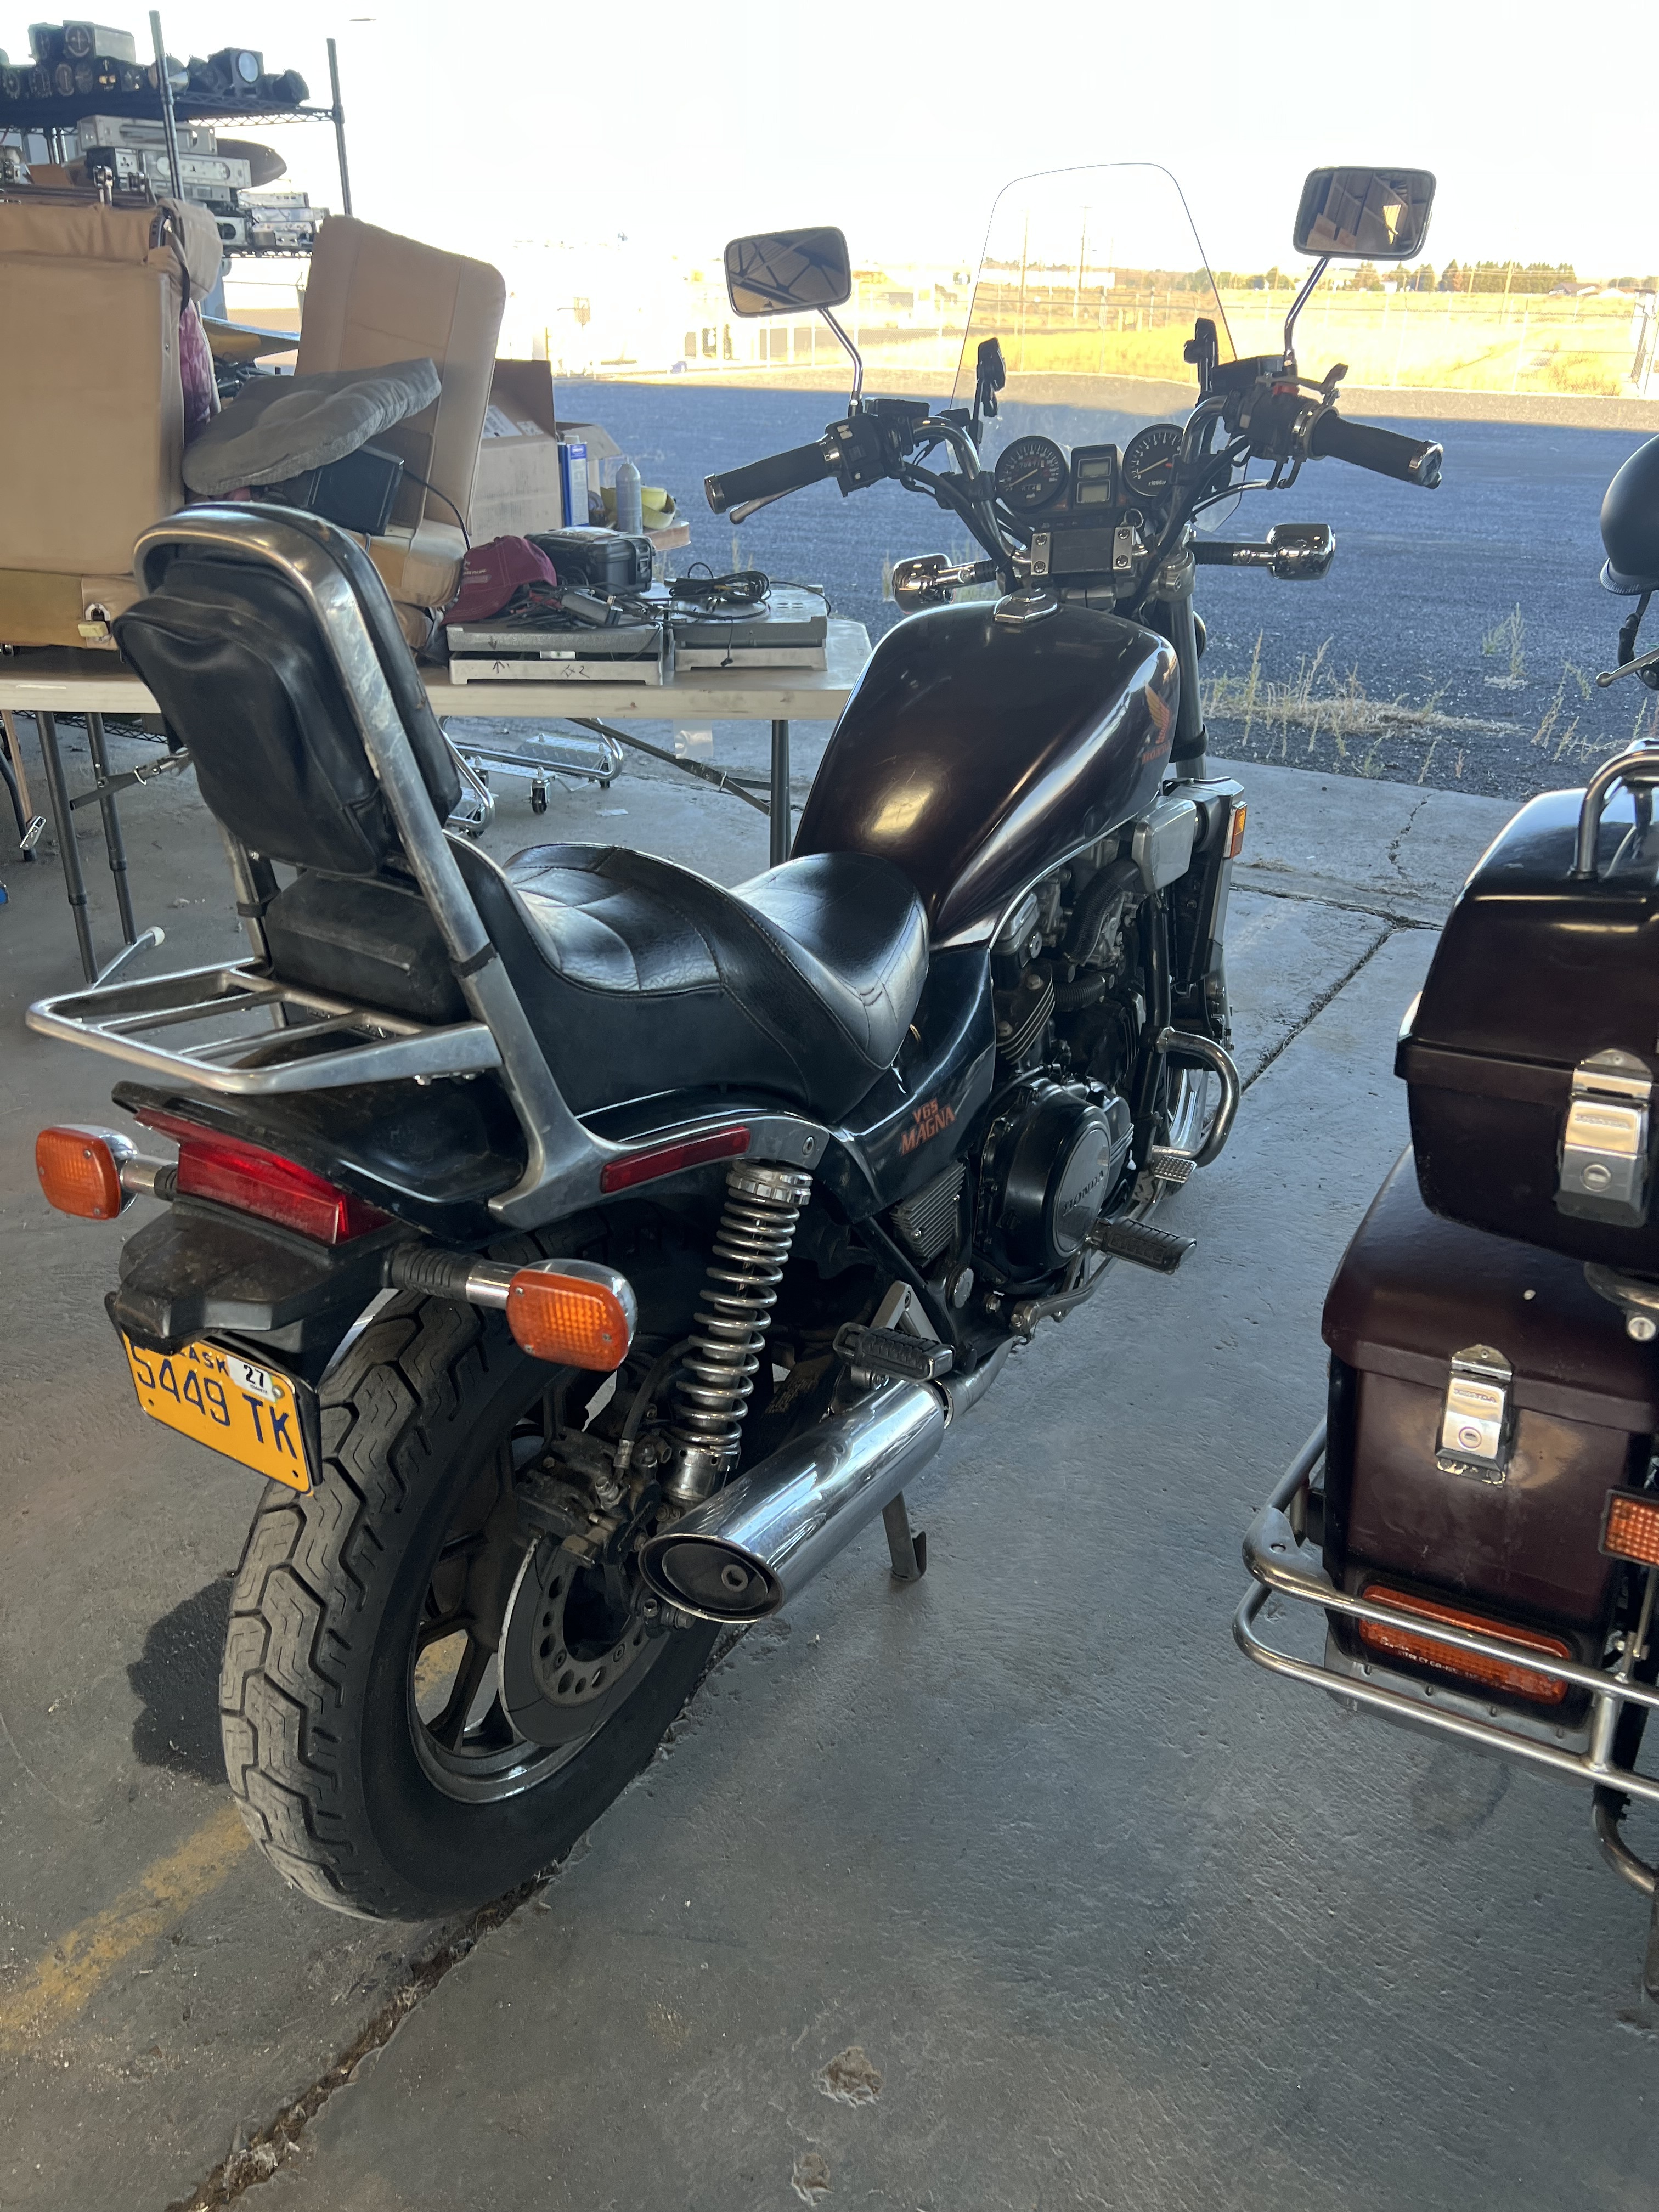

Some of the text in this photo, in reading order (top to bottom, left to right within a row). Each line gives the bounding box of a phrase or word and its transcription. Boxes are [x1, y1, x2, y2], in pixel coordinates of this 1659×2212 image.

[901, 1103, 957, 1157] MAGNA
[912, 1097, 939, 1124] V65
[1064, 1170, 1104, 1215] HONDA
[243, 1364, 264, 1388] 27
[129, 1340, 297, 1460] 5449 TK
